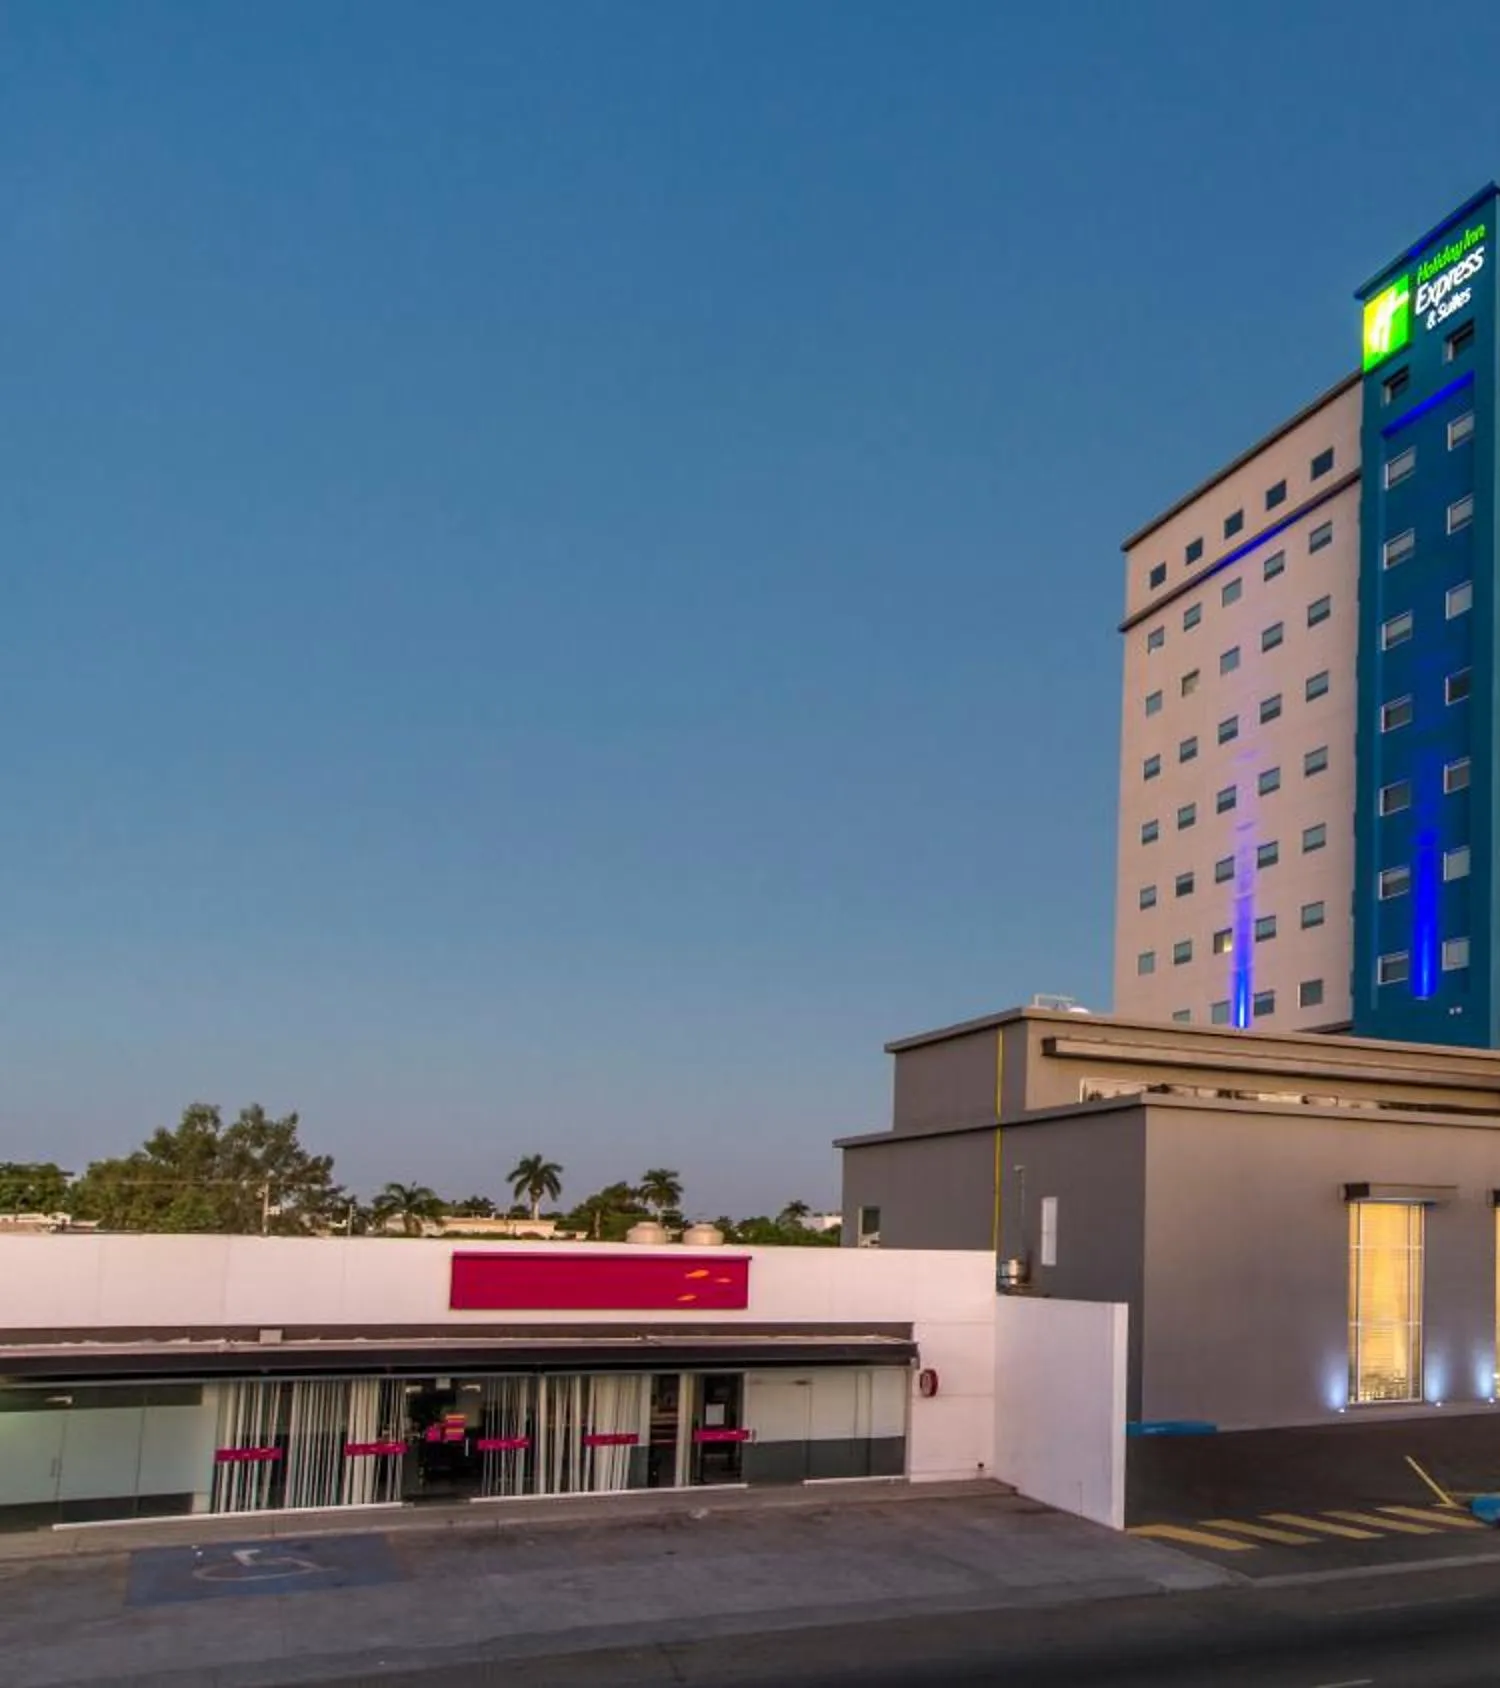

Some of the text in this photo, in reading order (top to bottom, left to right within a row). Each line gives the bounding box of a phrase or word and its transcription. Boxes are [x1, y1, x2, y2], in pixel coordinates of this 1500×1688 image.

[1415, 245, 1486, 316] Express
[1417, 223, 1486, 285] Holiday Inn
